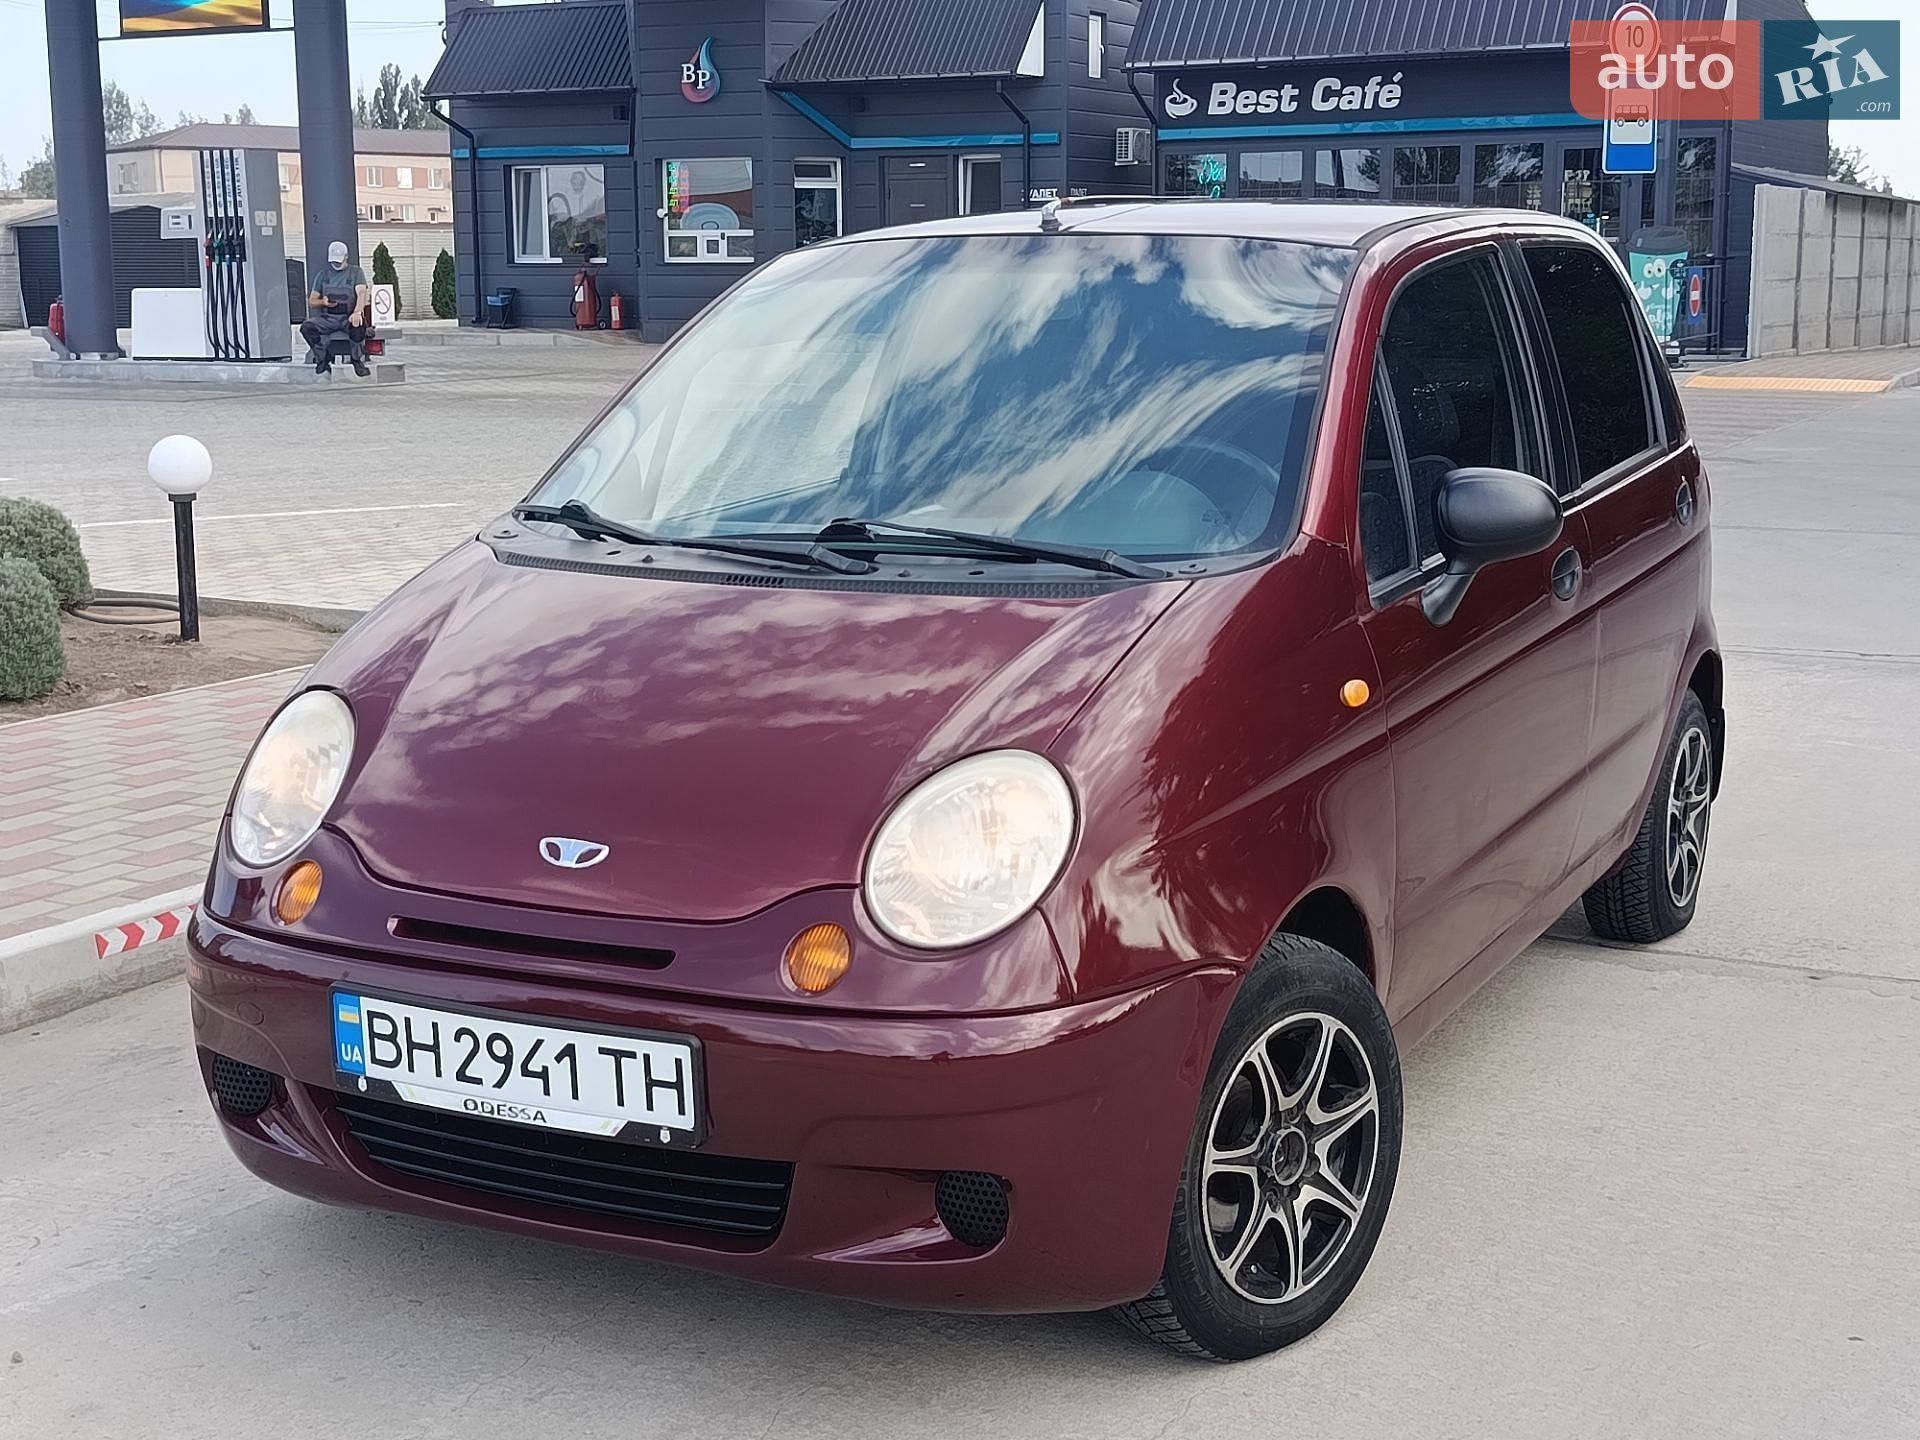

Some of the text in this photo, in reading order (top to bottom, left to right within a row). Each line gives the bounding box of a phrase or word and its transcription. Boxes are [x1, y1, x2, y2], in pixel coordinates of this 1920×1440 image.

[1624, 25, 1644, 48] 10
[681, 63, 711, 90] BP
[1207, 71, 1403, 115] Best Café
[341, 1042, 363, 1065] UA
[367, 1010, 686, 1116] BH 2941 TH
[463, 1097, 548, 1124] ODESSA
